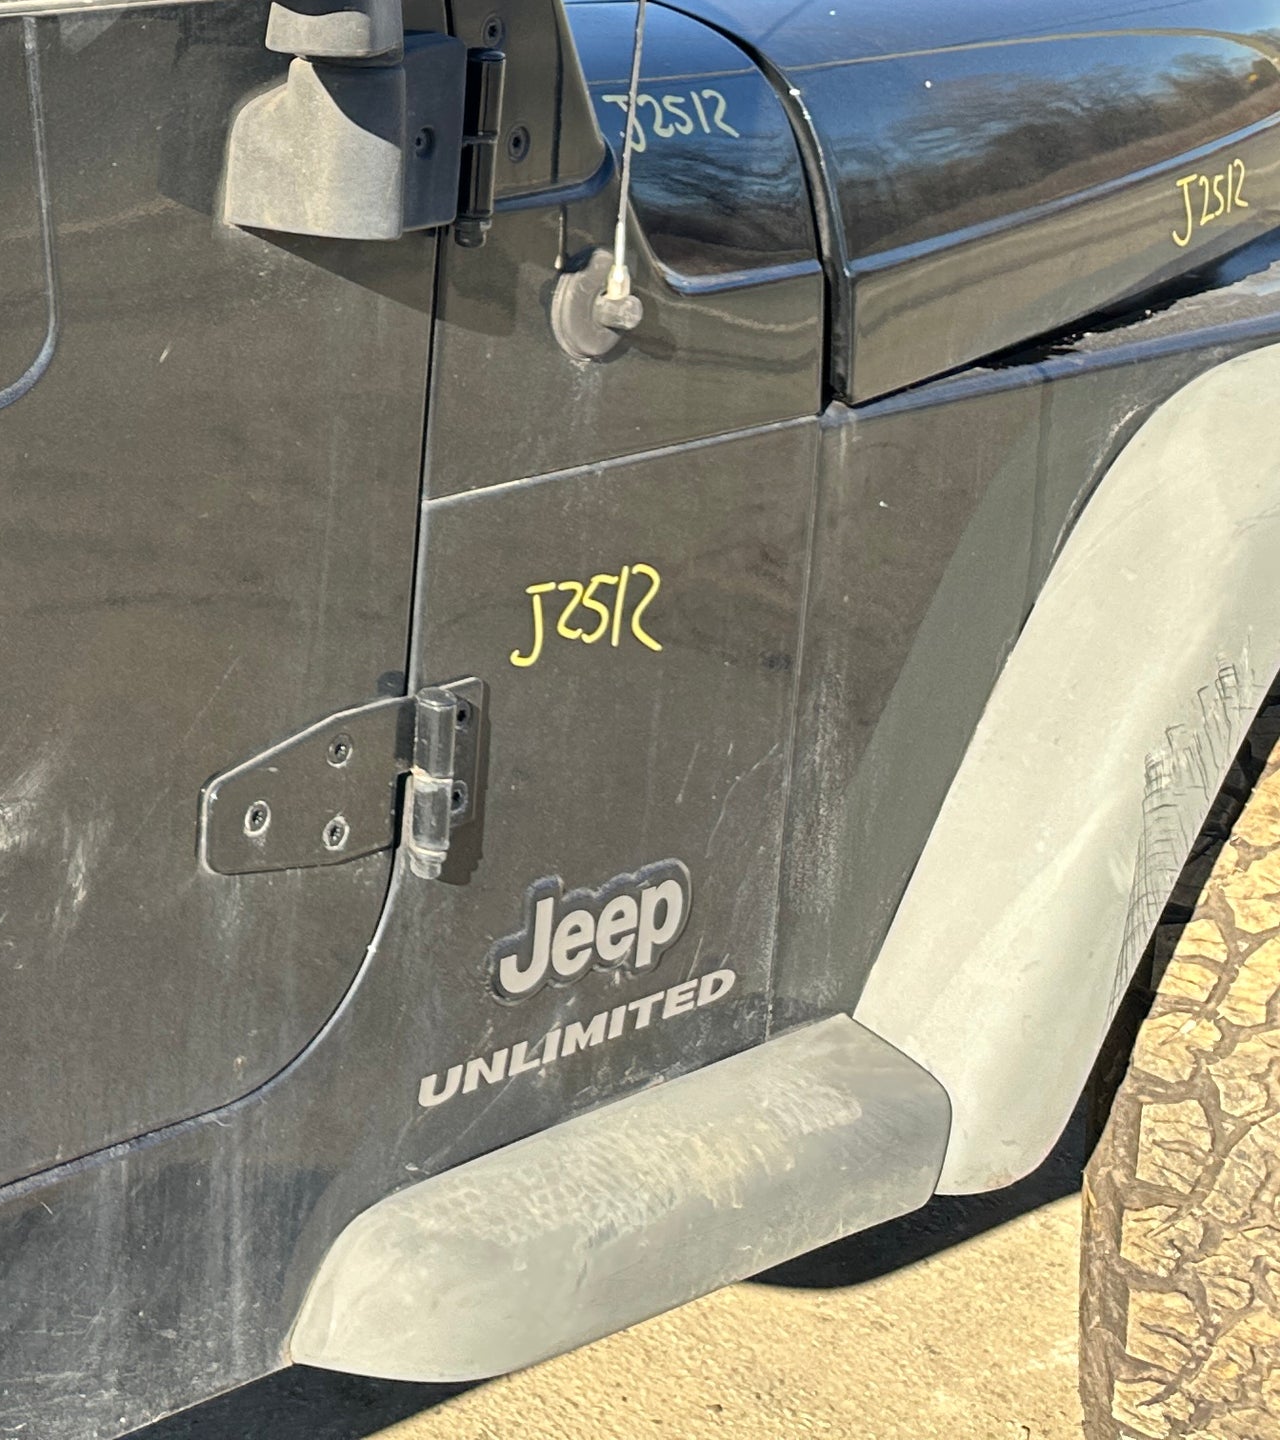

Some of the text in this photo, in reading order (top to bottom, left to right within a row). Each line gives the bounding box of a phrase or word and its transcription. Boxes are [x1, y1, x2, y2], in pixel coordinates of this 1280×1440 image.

[601, 88, 740, 153] J2512
[1172, 158, 1249, 247] J2512
[510, 563, 662, 667] J2512
[500, 879, 684, 994] Jeep
[417, 968, 737, 1108] UNLIMITED
